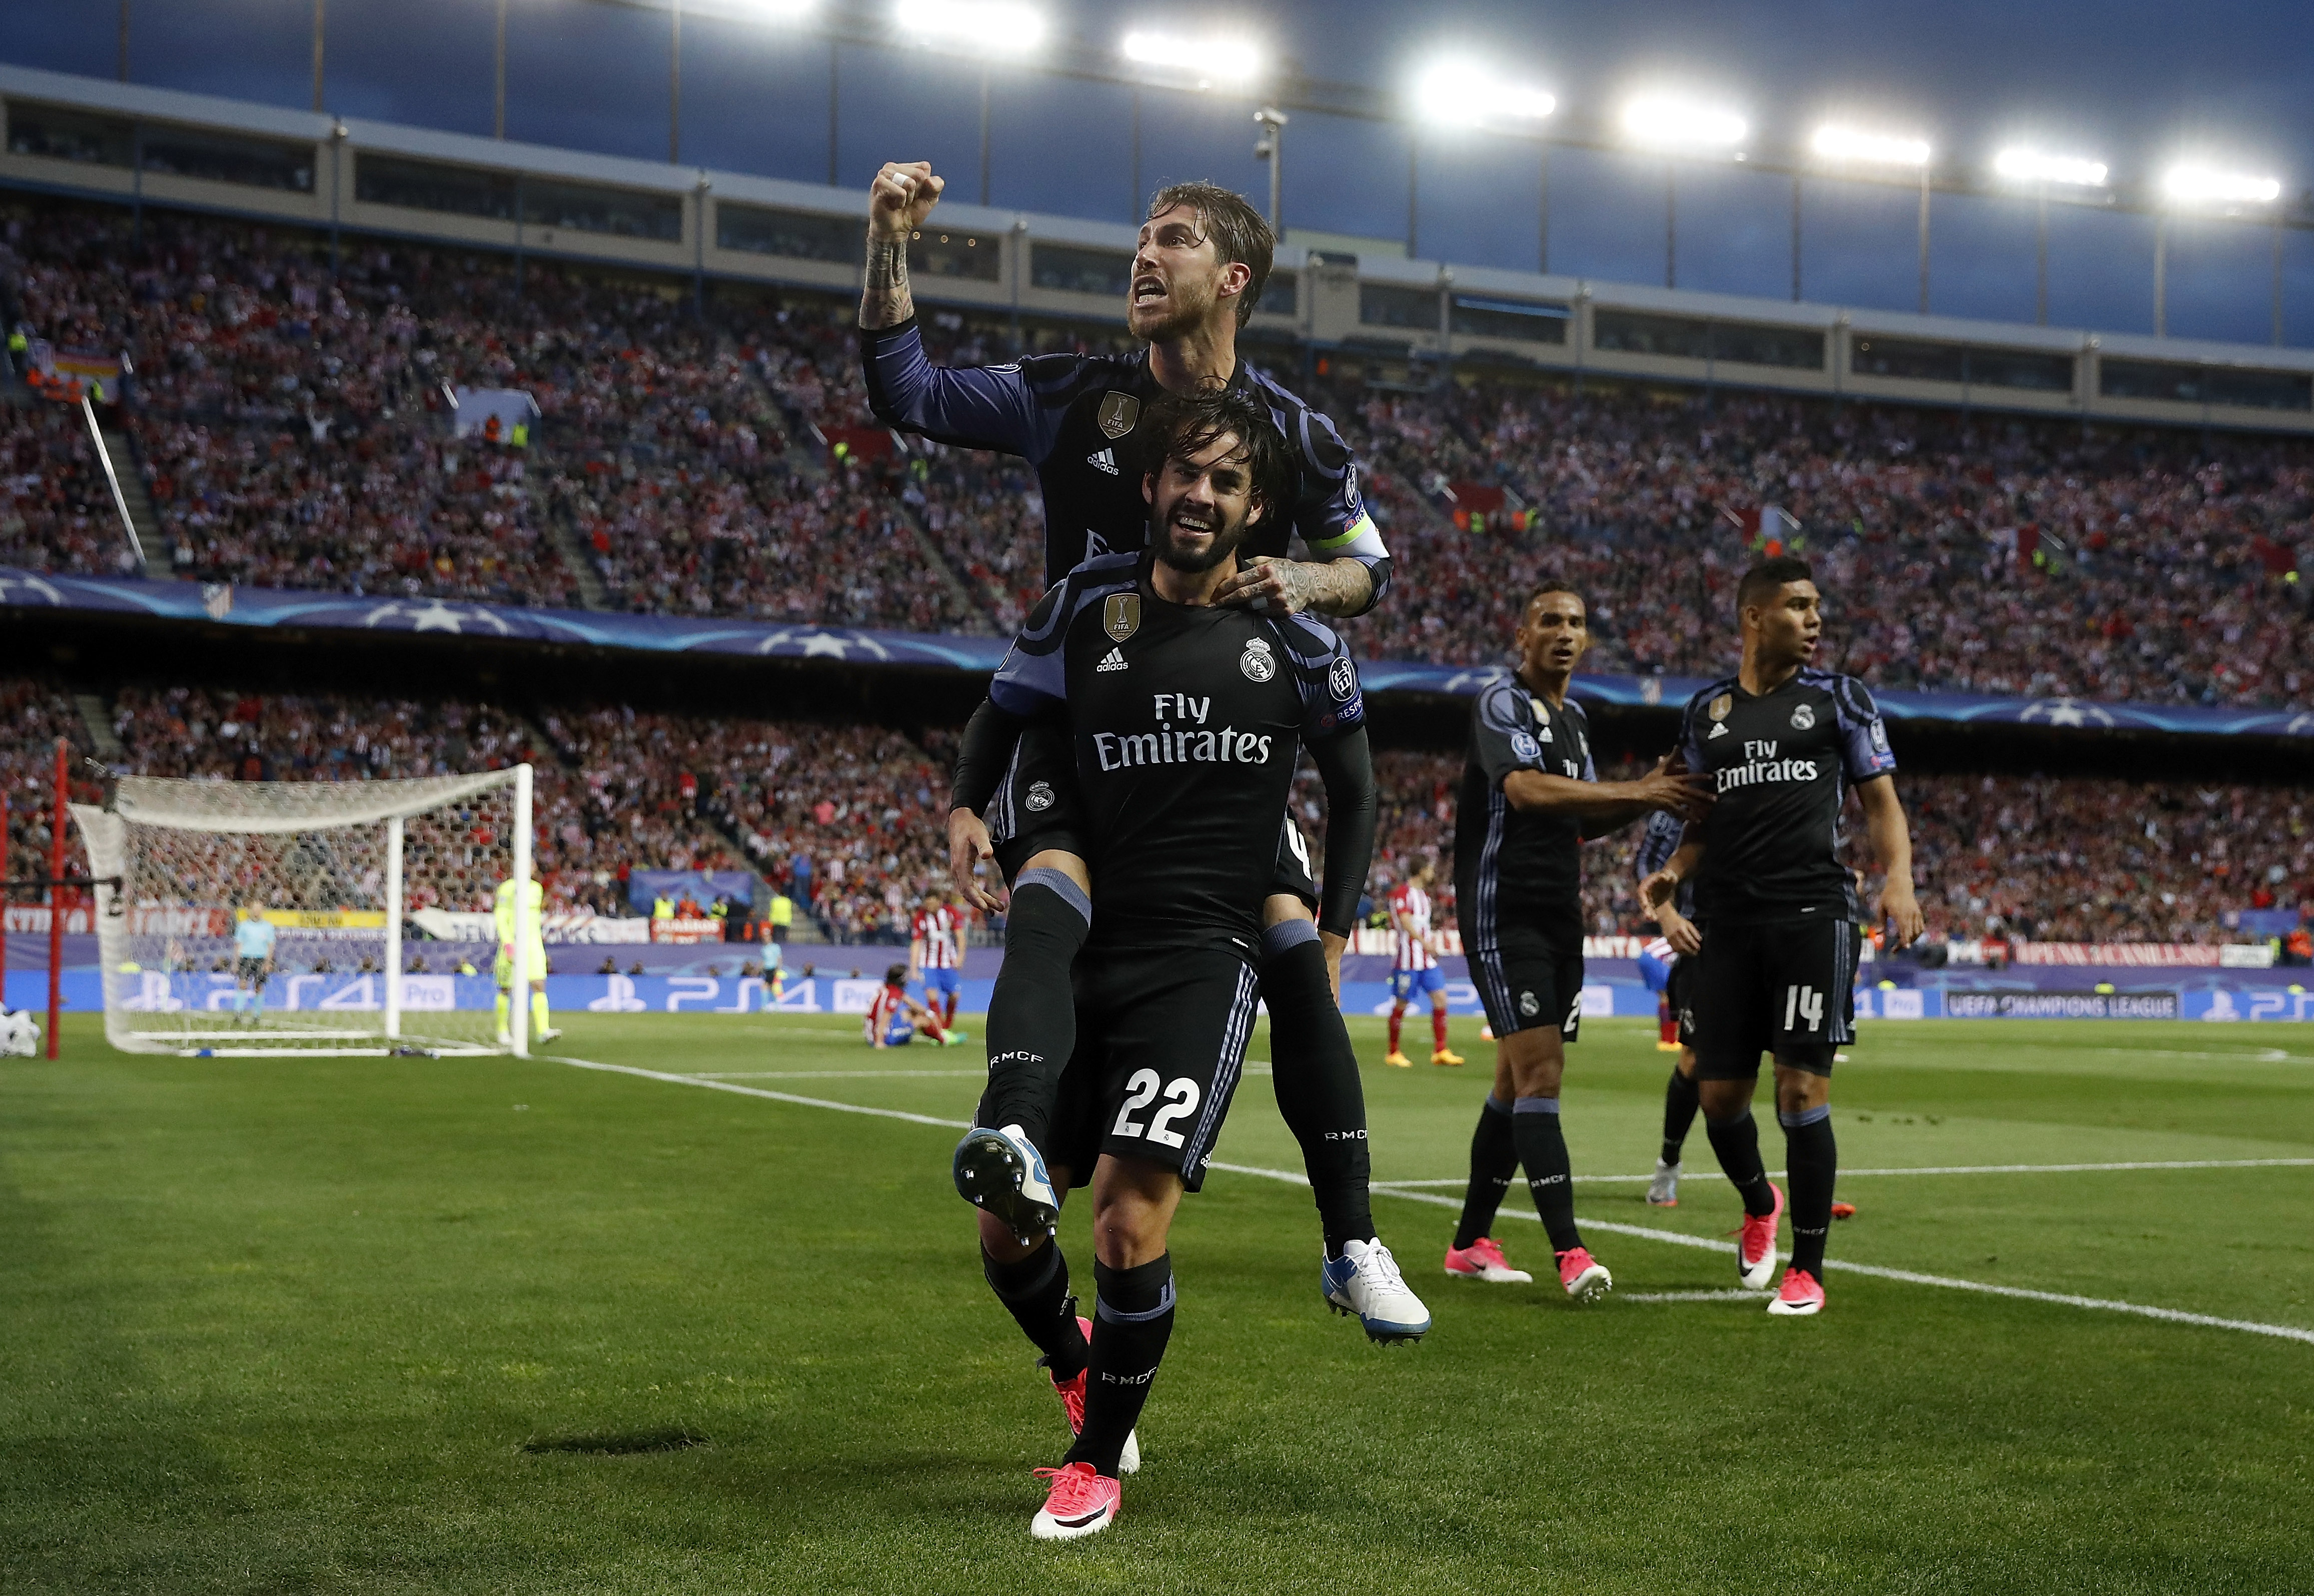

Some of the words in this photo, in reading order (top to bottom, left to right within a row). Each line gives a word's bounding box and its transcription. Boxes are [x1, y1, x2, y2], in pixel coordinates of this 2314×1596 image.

[1107, 419, 1123, 429] FIFA
[1087, 456, 1119, 476] adidas
[1096, 661, 1129, 672] adidas
[1339, 676, 1351, 692] 11
[1153, 693, 1211, 724] Fly
[1093, 722, 1272, 771] Emirates
[1744, 739, 1778, 759] Fly
[1715, 757, 1818, 794] Emirates
[1286, 817, 1313, 881] 4
[408, 983, 445, 1001] Pro
[666, 977, 823, 1013] PS4
[1784, 984, 1824, 1032] 14
[1950, 995, 1997, 1016] UEFA
[2000, 995, 2106, 1017] CHAMPIONS
[2108, 995, 2176, 1018] LEAGUE
[990, 1051, 1044, 1069] RMCF
[1111, 1068, 1201, 1149] 22
[1102, 1366, 1157, 1384] RMCF
